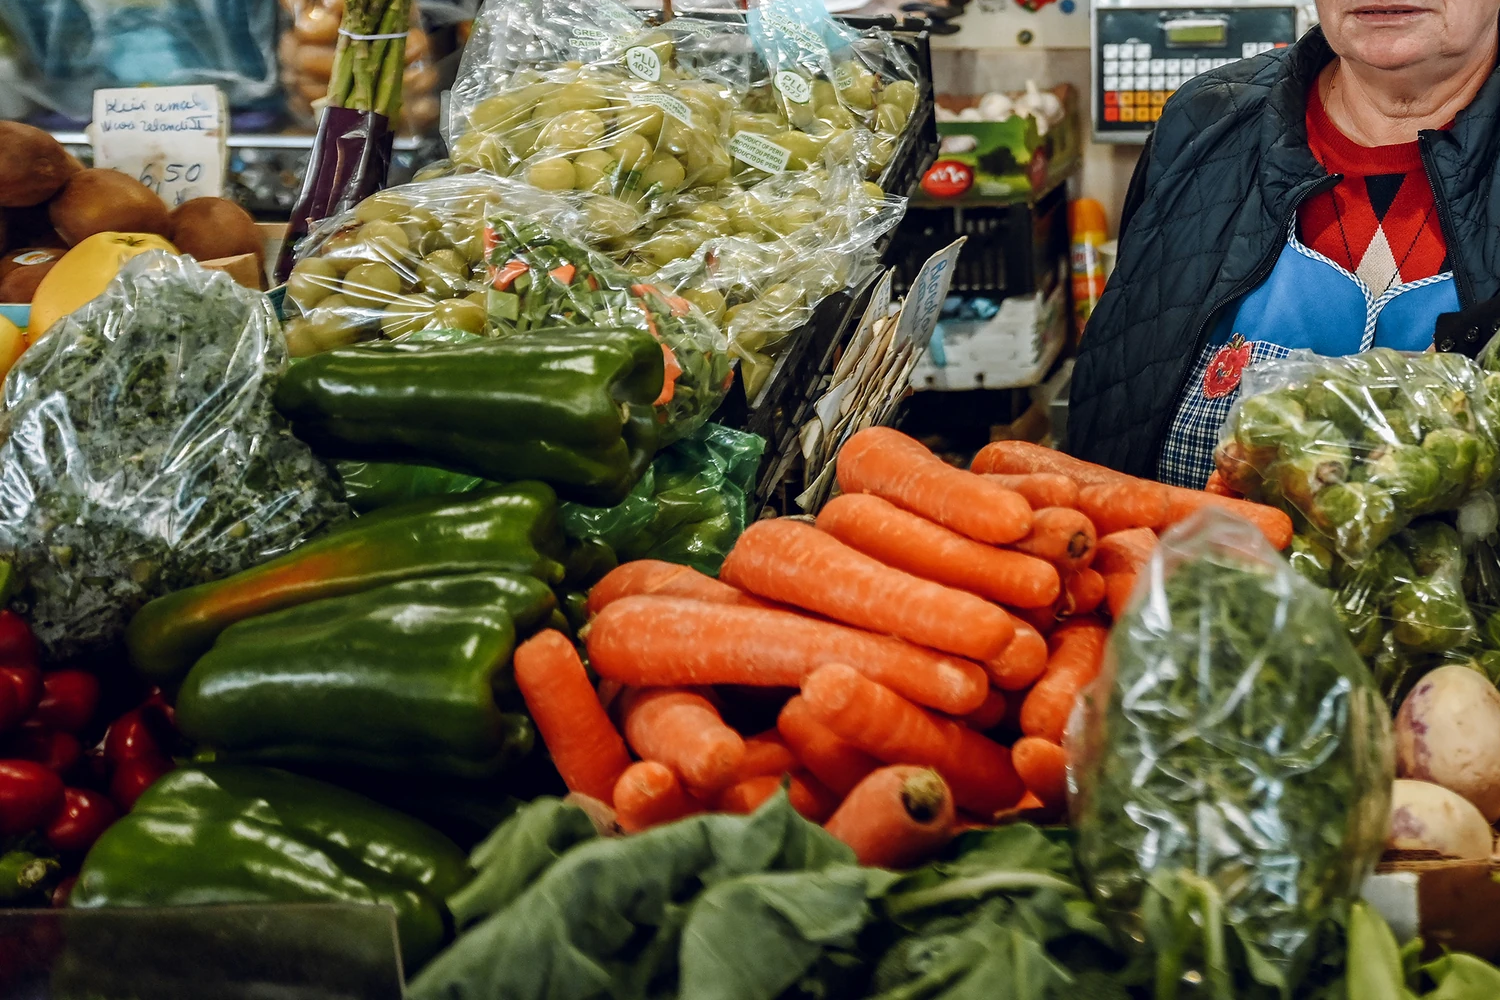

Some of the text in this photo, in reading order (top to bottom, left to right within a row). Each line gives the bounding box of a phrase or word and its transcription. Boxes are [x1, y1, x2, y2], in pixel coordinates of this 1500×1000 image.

[633, 50, 657, 69] PLU
[632, 61, 654, 79] 4022
[782, 74, 806, 94] PLU
[732, 138, 756, 152] PRODUIT
[763, 151, 783, 165] PEROU
[738, 133, 762, 147] PRODUCT
[769, 146, 785, 157] PERU
